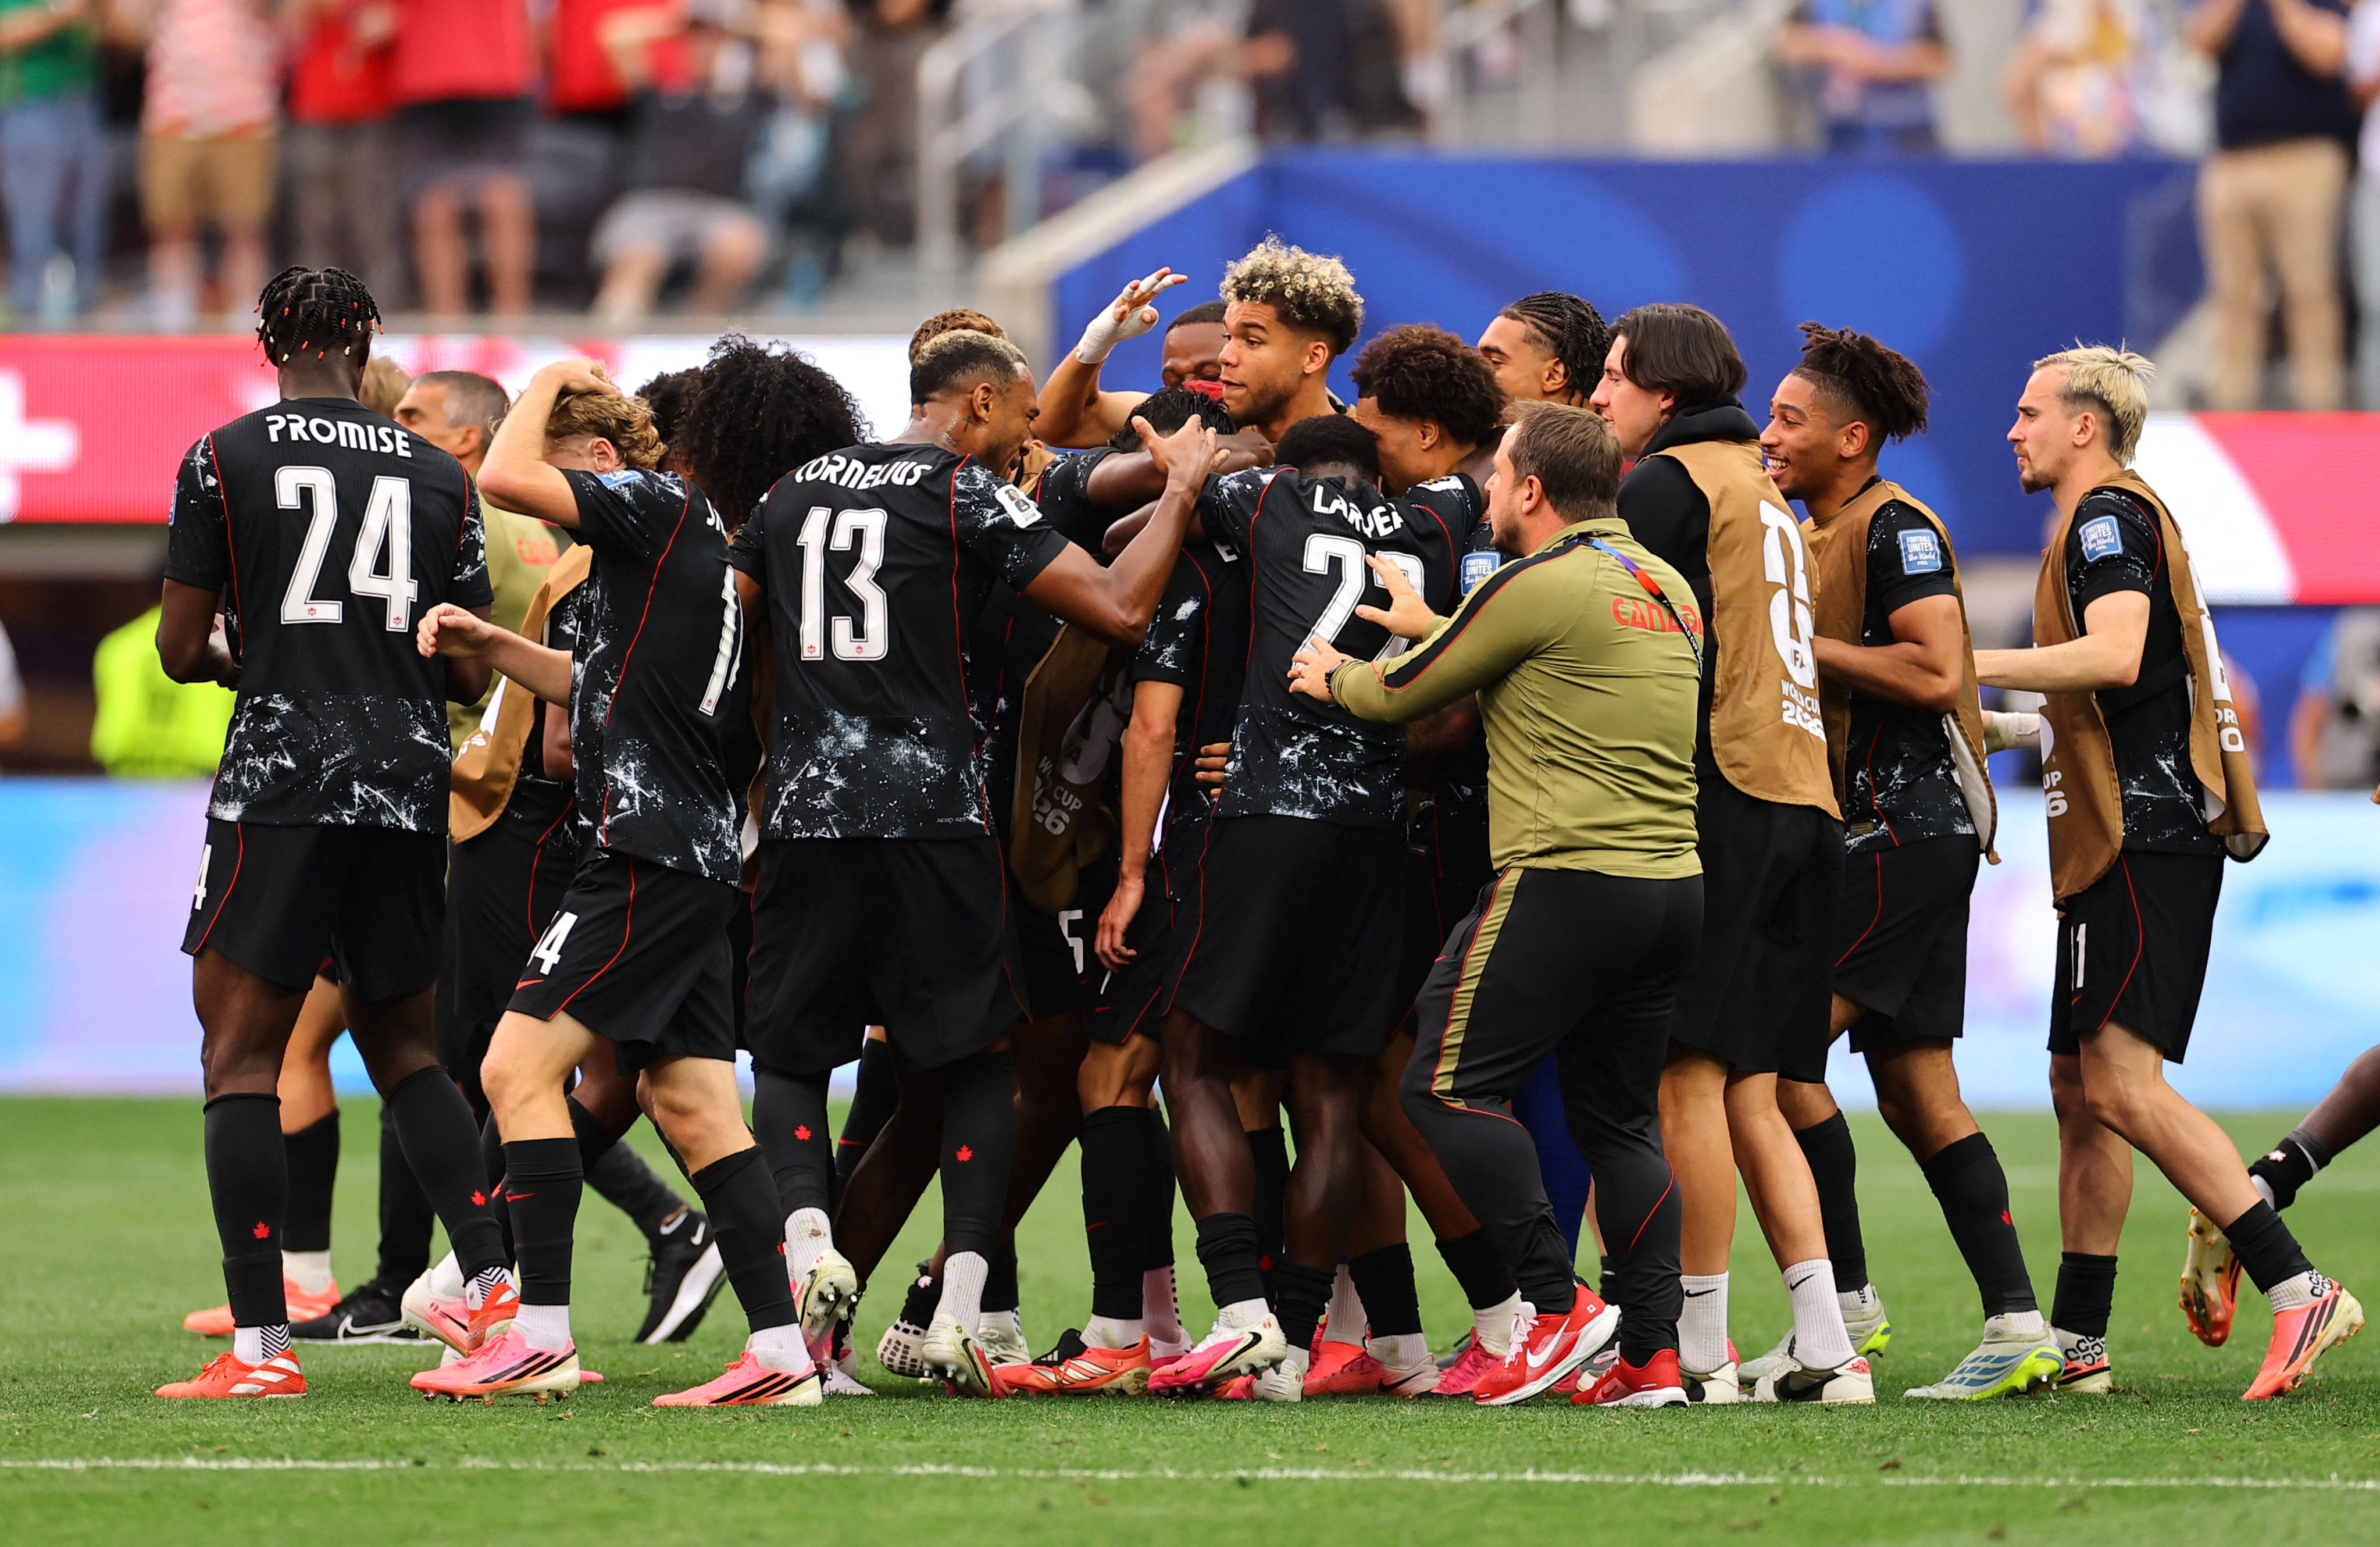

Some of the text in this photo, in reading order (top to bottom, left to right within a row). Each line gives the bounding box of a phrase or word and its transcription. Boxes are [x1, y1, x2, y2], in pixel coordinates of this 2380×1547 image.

[265, 414, 412, 458] PROMISE
[795, 454, 933, 490] CORNELIUS
[1906, 535, 1931, 543] FOOTBALL
[2087, 527, 2112, 542] UNITES
[274, 466, 418, 632] 24
[1907, 543, 1934, 552] UNITES
[1907, 551, 1936, 561] the World
[1466, 558, 1492, 566] FOOTBALL
[1466, 565, 1492, 576] UNITES
[797, 507, 889, 661] 13
[1464, 575, 1475, 584] the
[2043, 771, 2063, 790] UP
[1053, 786, 1083, 811] CUP
[526, 910, 578, 976] 4
